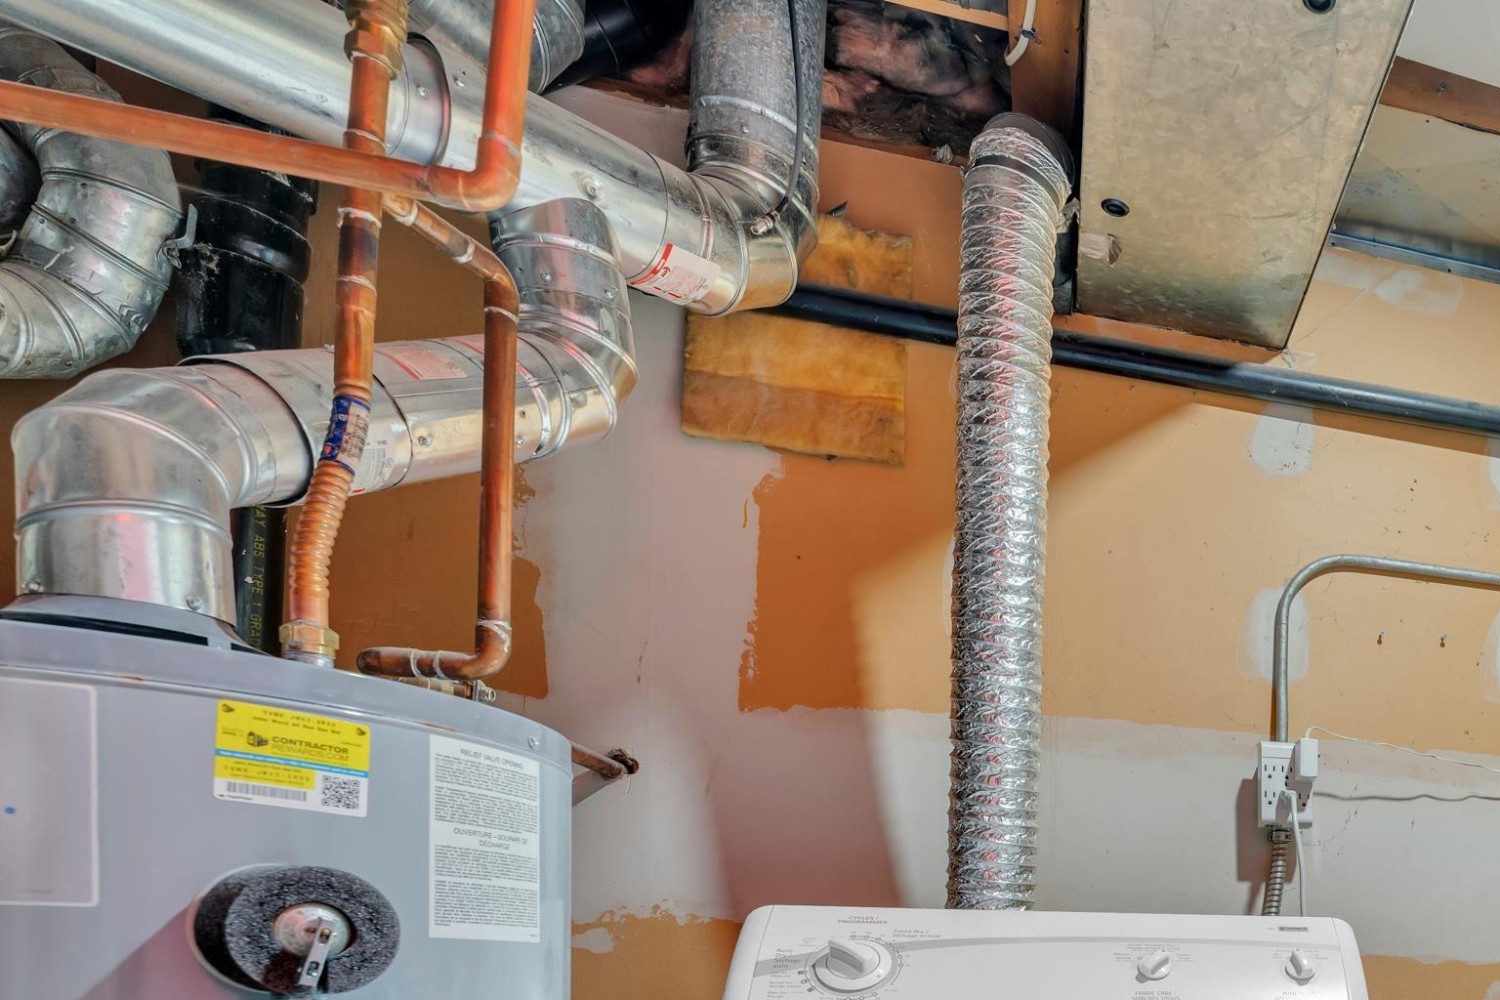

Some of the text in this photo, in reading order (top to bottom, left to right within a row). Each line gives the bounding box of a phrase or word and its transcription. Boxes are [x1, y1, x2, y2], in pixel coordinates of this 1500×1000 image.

[252, 534, 265, 596] ABS TYPE
[272, 736, 349, 754] CONTRACTOR
[272, 743, 349, 761] REWARDS.COM
[460, 748, 482, 758] RELIEF
[453, 827, 492, 839] OUVERTURE
